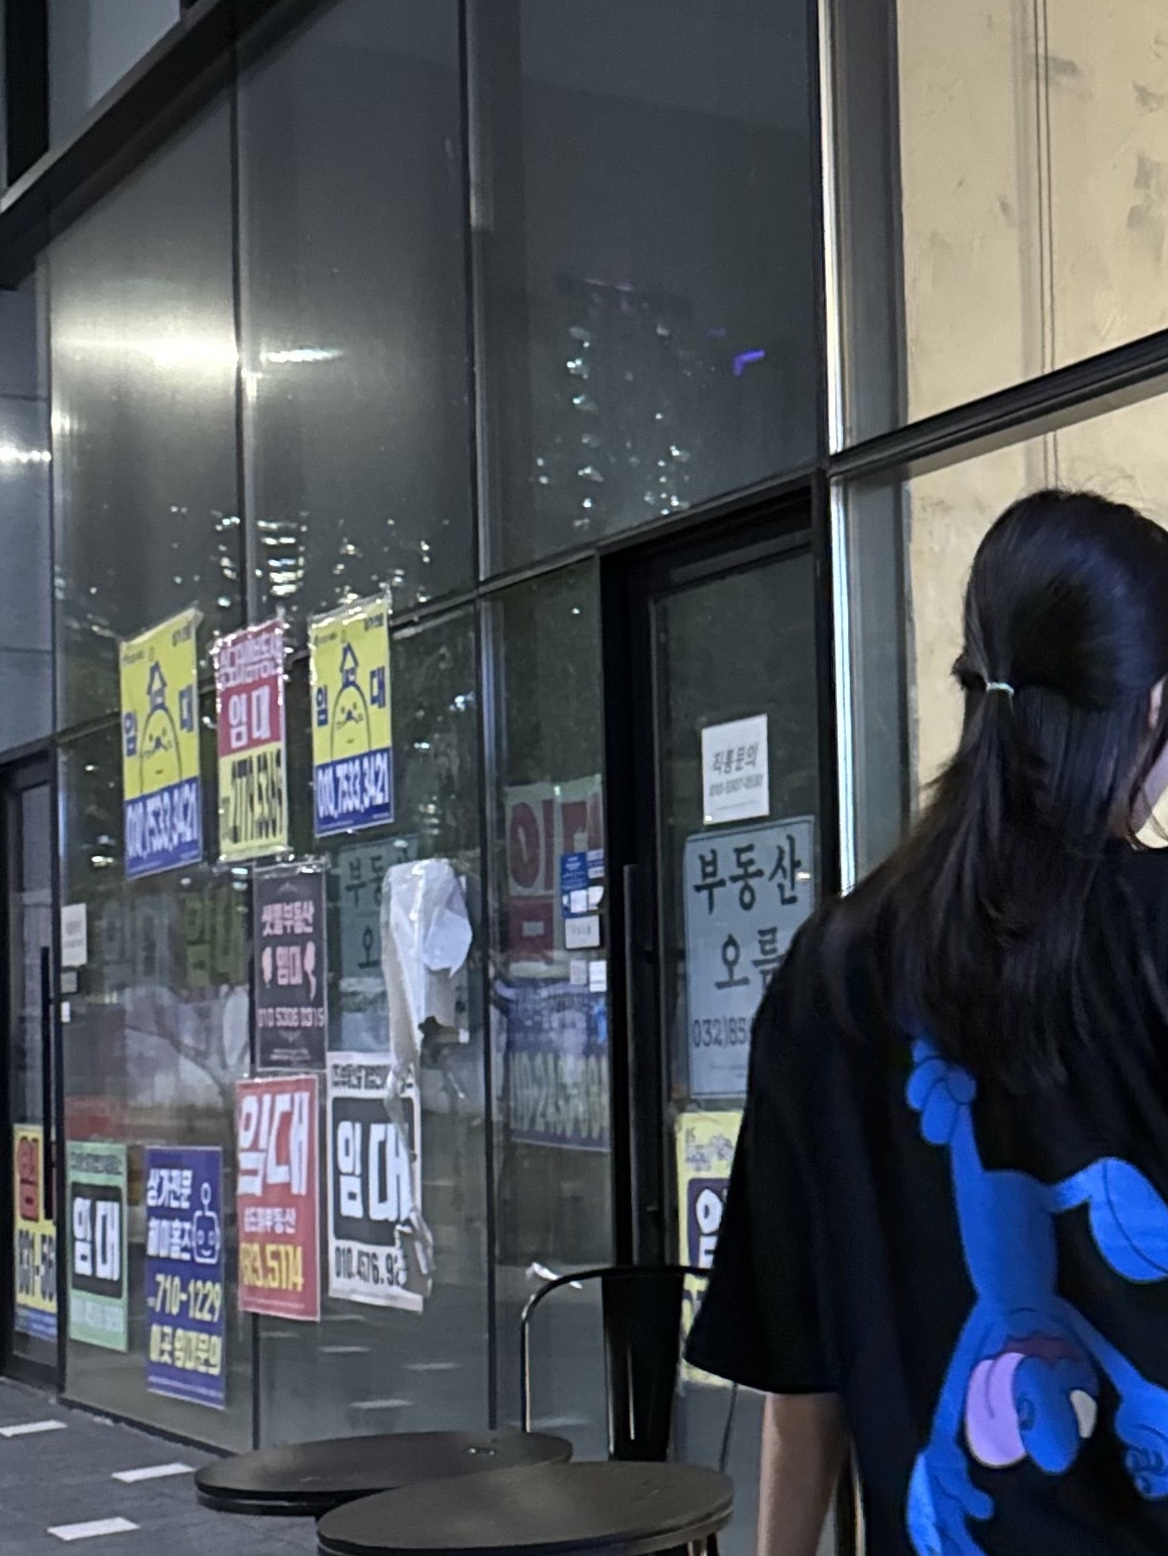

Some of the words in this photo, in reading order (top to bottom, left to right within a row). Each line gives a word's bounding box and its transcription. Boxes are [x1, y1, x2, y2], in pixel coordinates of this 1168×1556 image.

[228, 685, 271, 749] 임대
[692, 834, 802, 915] 부동산
[275, 944, 303, 986] 임대
[237, 1091, 310, 1197] 임대
[336, 1120, 414, 1222] 임대
[73, 1196, 121, 1282] 임대
[155, 1273, 222, 1323] 710-1229
